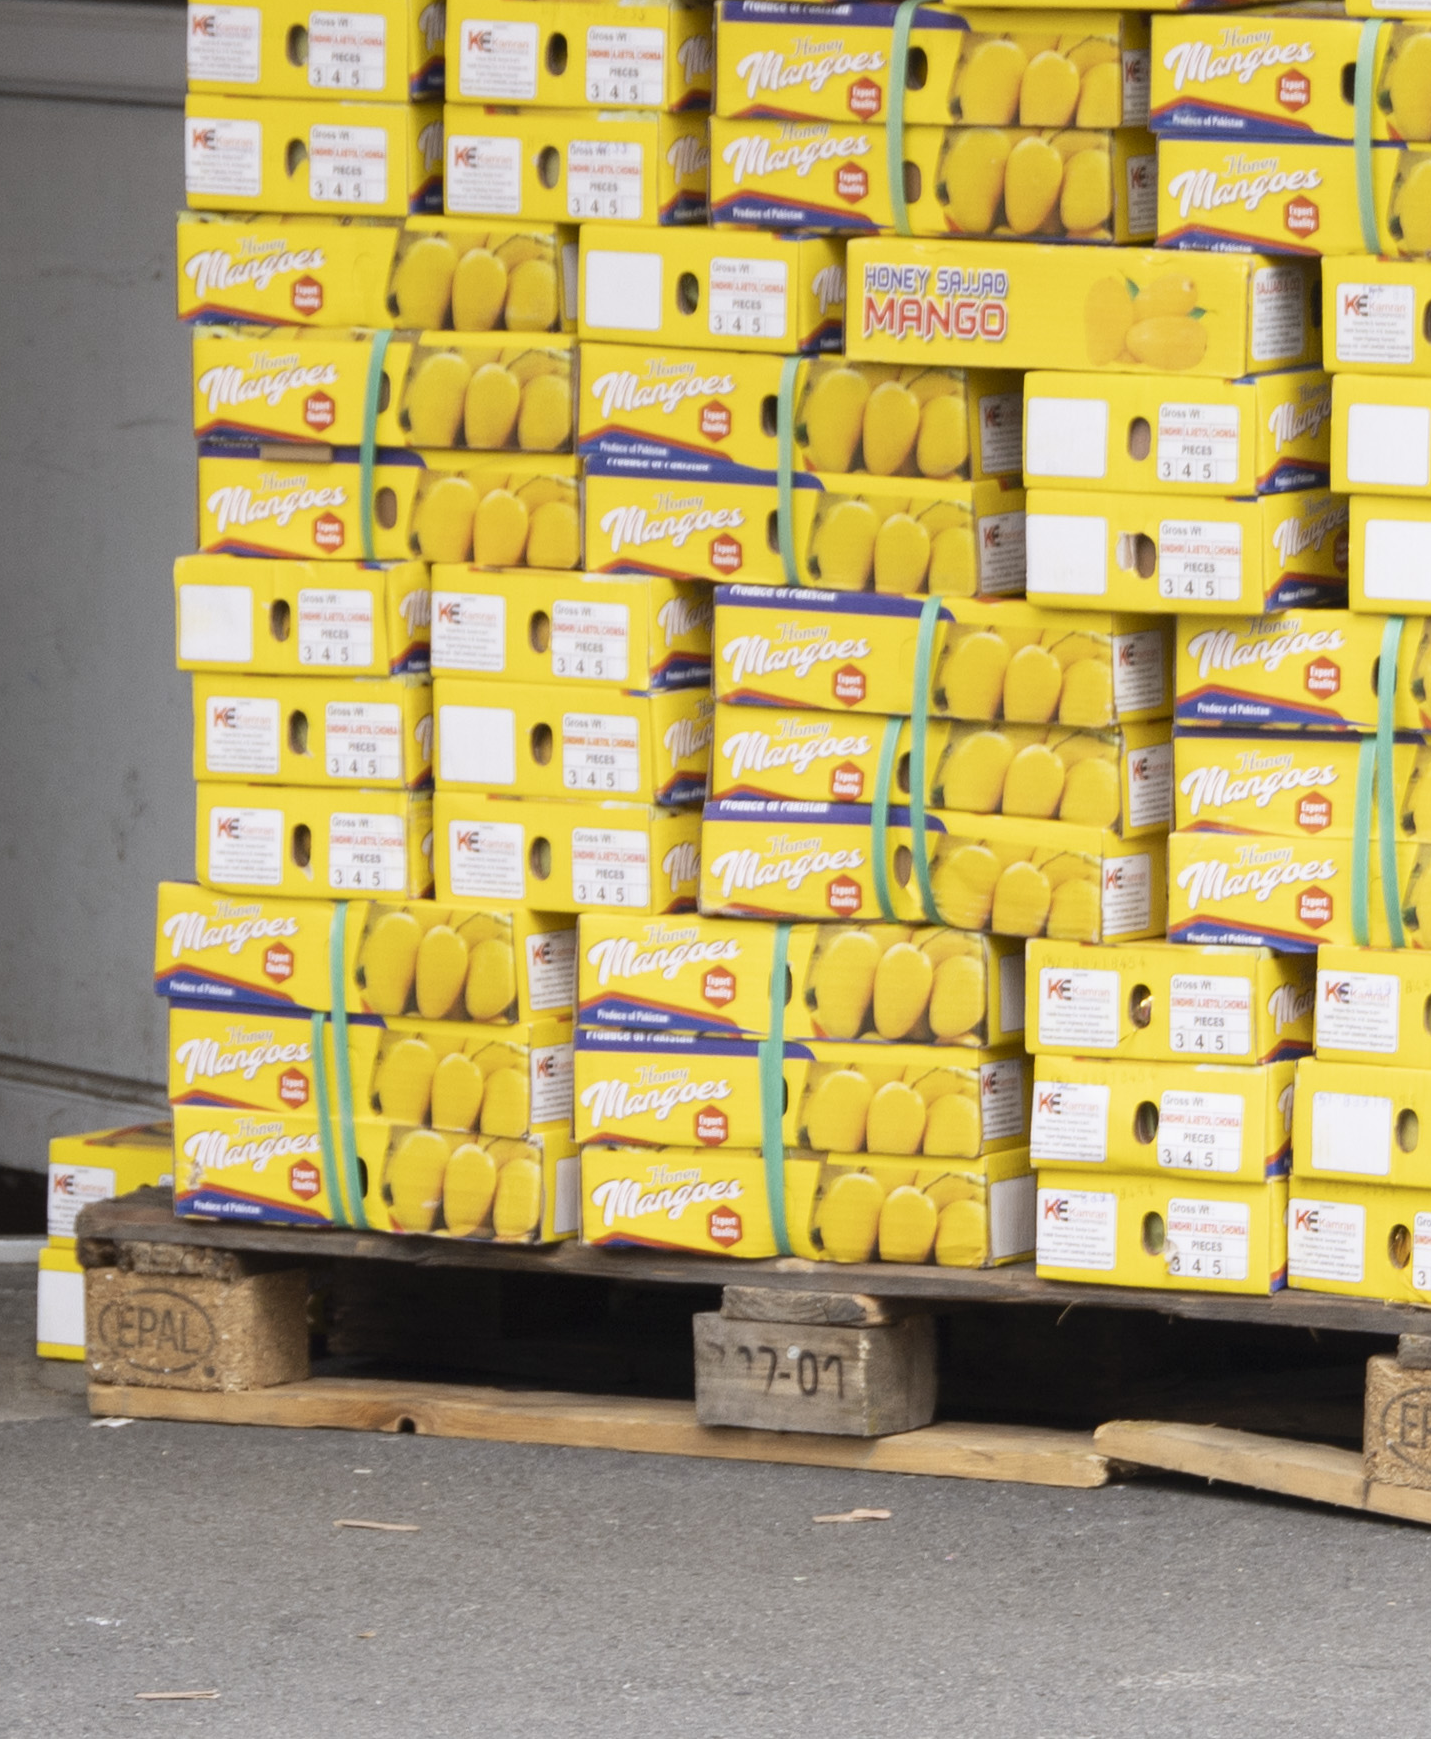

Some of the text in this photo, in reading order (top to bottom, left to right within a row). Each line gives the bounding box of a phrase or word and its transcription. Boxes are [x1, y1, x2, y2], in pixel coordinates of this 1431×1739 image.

[792, 36, 844, 57] Honey
[1223, 27, 1275, 48] Honey
[737, 50, 886, 99] Mangoes
[1164, 42, 1314, 91] Mangoes
[1279, 78, 1308, 91] Export
[1279, 91, 1308, 103] Quality
[1172, 113, 1203, 126] Produce
[1214, 117, 1244, 129] Pakistan
[1168, 165, 1322, 215] Mangoes
[185, 249, 325, 297] Mangoes
[864, 263, 1009, 297] HONEY SAJJAD
[1344, 294, 1369, 317] KE
[863, 294, 1008, 341] MANGO
[592, 372, 735, 418] Mangoes
[776, 623, 830, 644] Honey
[1245, 616, 1301, 637] Honey
[722, 634, 871, 682] Mangoes
[1187, 629, 1346, 678] Mangoes
[1307, 666, 1337, 678] Export
[1307, 678, 1337, 691] Quality
[1197, 703, 1227, 716] Produce
[1238, 705, 1270, 717] Pakistan
[1177, 857, 1336, 909] Mangoes
[213, 899, 261, 920] Honey
[163, 913, 298, 958] Mangoes
[266, 951, 292, 962] Export
[266, 962, 293, 973] Quality
[587, 939, 741, 985] Mangoes
[170, 983, 200, 994] Produce
[209, 985, 235, 998] Pakistan
[581, 1077, 732, 1127] Mangoes
[115, 1305, 202, 1355] EPAL
